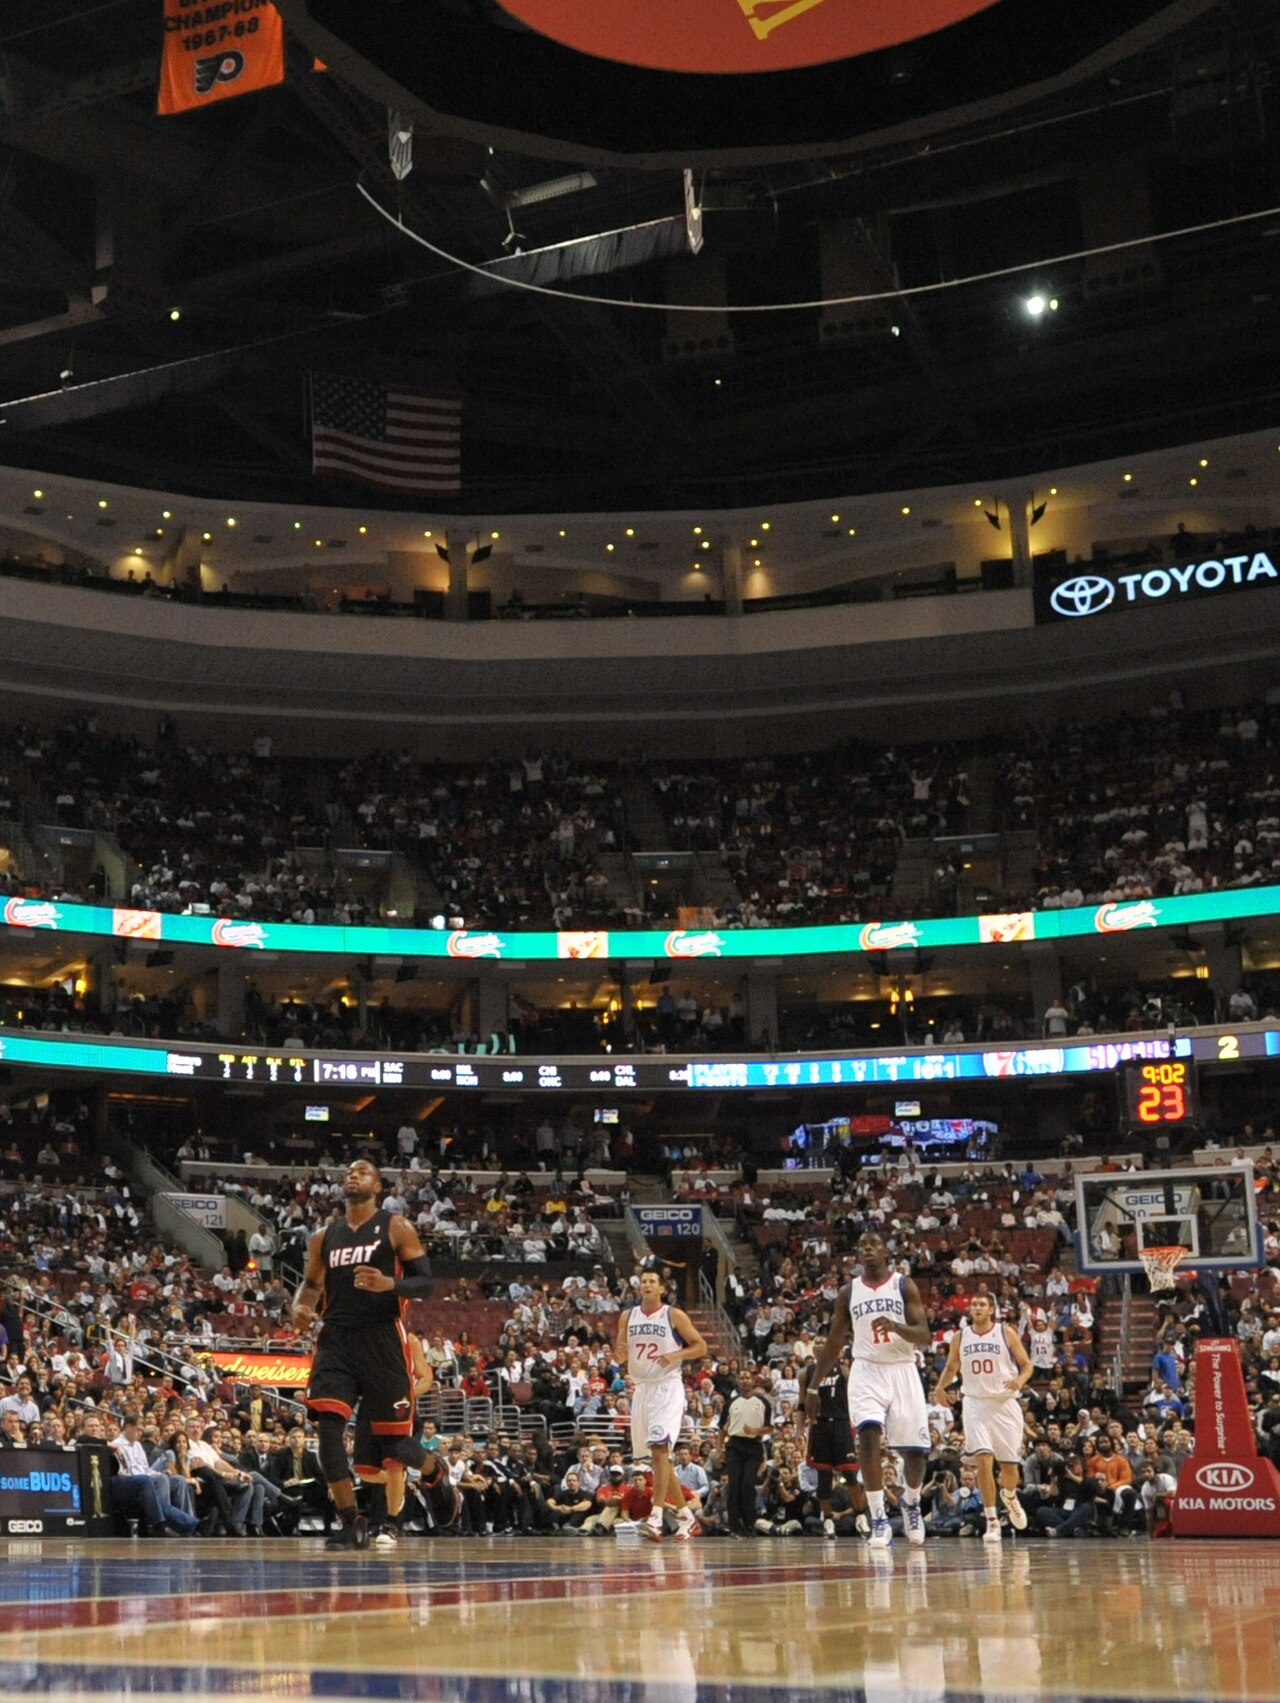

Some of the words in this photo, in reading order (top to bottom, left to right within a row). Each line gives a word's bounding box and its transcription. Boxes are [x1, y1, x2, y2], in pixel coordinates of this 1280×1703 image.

[1118, 552, 1278, 601] TOYOTA
[1218, 1036, 1239, 1059] 2
[1142, 1063, 1185, 1084] 9:02
[1139, 1085, 1185, 1121] 23
[205, 1215, 224, 1226] 121
[640, 1209, 693, 1220] GEICO
[677, 1223, 700, 1235] 120
[329, 1239, 382, 1268] HEAT
[852, 1299, 904, 1321] SIXERS
[628, 1323, 667, 1338] SIXERS
[635, 1343, 658, 1360] 72
[963, 1342, 1001, 1357] SIXERS
[197, 1352, 312, 1381] dweiser
[971, 1359, 994, 1375] 00
[1212, 1353, 1220, 1370] The
[1213, 1371, 1222, 1399] Power
[1215, 1401, 1223, 1411] to
[1215, 1412, 1226, 1449] Surprise
[1, 1477, 29, 1490] SOME
[30, 1472, 71, 1491] BUDS
[1206, 1469, 1245, 1485] KIA
[1178, 1498, 1206, 1511] KIA
[1209, 1497, 1276, 1512] MOTORS
[8, 1519, 43, 1533] GEICO
